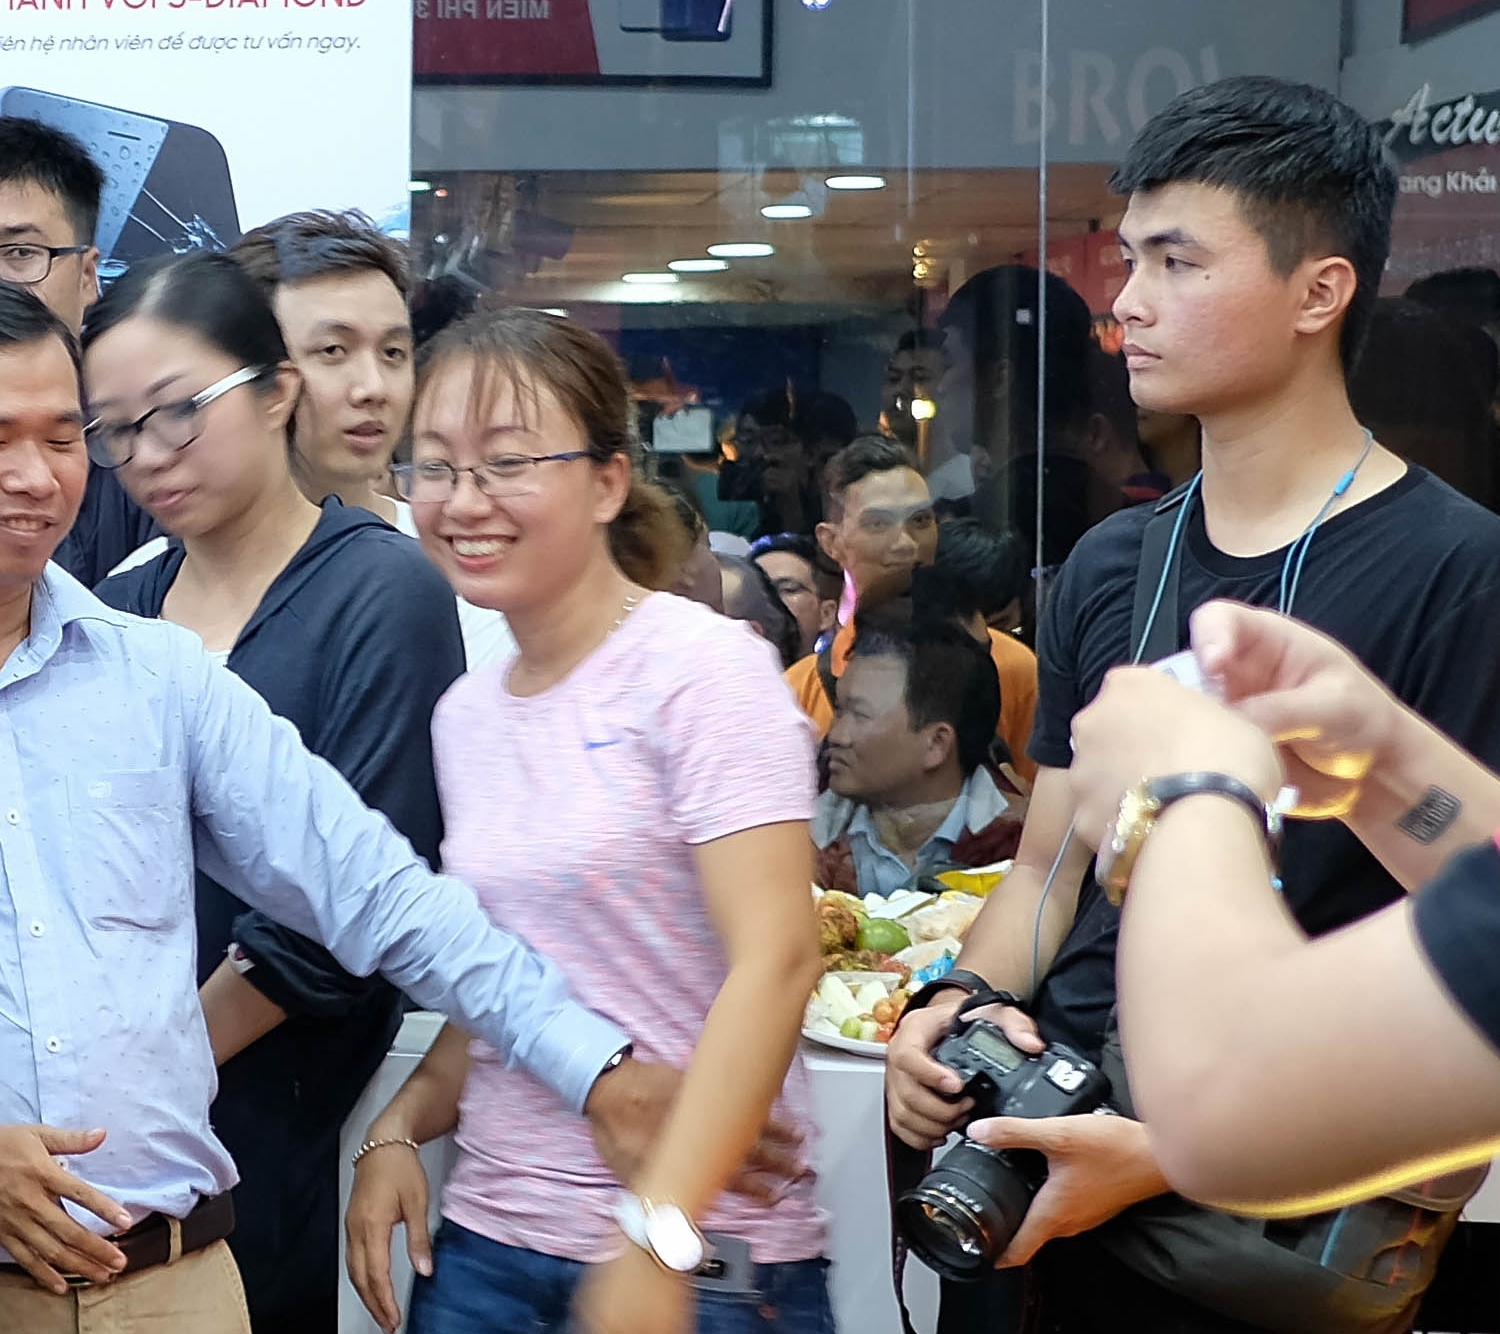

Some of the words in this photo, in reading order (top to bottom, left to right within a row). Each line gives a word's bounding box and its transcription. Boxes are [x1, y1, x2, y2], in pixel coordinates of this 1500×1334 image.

[31, 34, 54, 53] hệ
[59, 34, 109, 51] nhân
[115, 34, 153, 51] viên
[188, 32, 237, 55] được
[267, 29, 302, 50] vấn
[307, 34, 361, 57] ngay.
